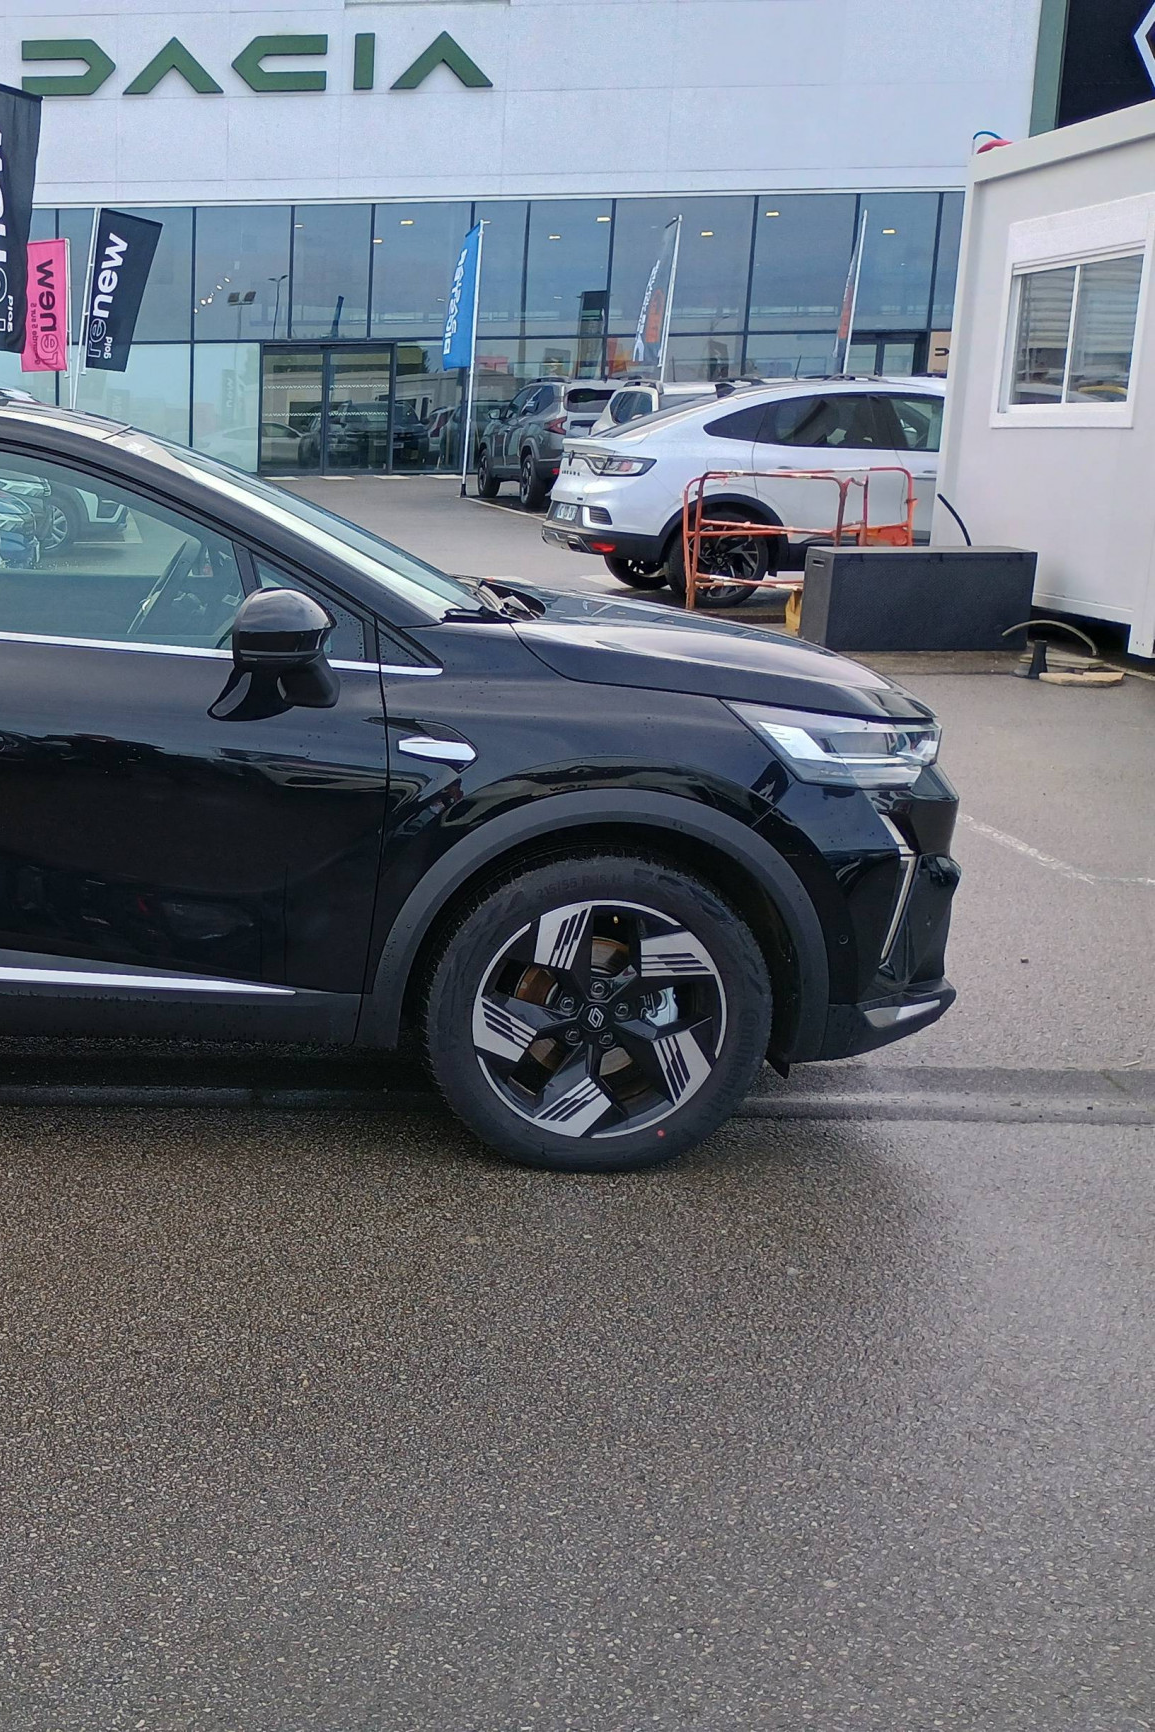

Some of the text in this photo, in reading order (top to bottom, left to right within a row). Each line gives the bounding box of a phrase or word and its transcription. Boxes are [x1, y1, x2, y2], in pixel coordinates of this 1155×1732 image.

[21, 30, 493, 97] DACIA
[87, 232, 128, 358] renew
[103, 336, 113, 360] gold
